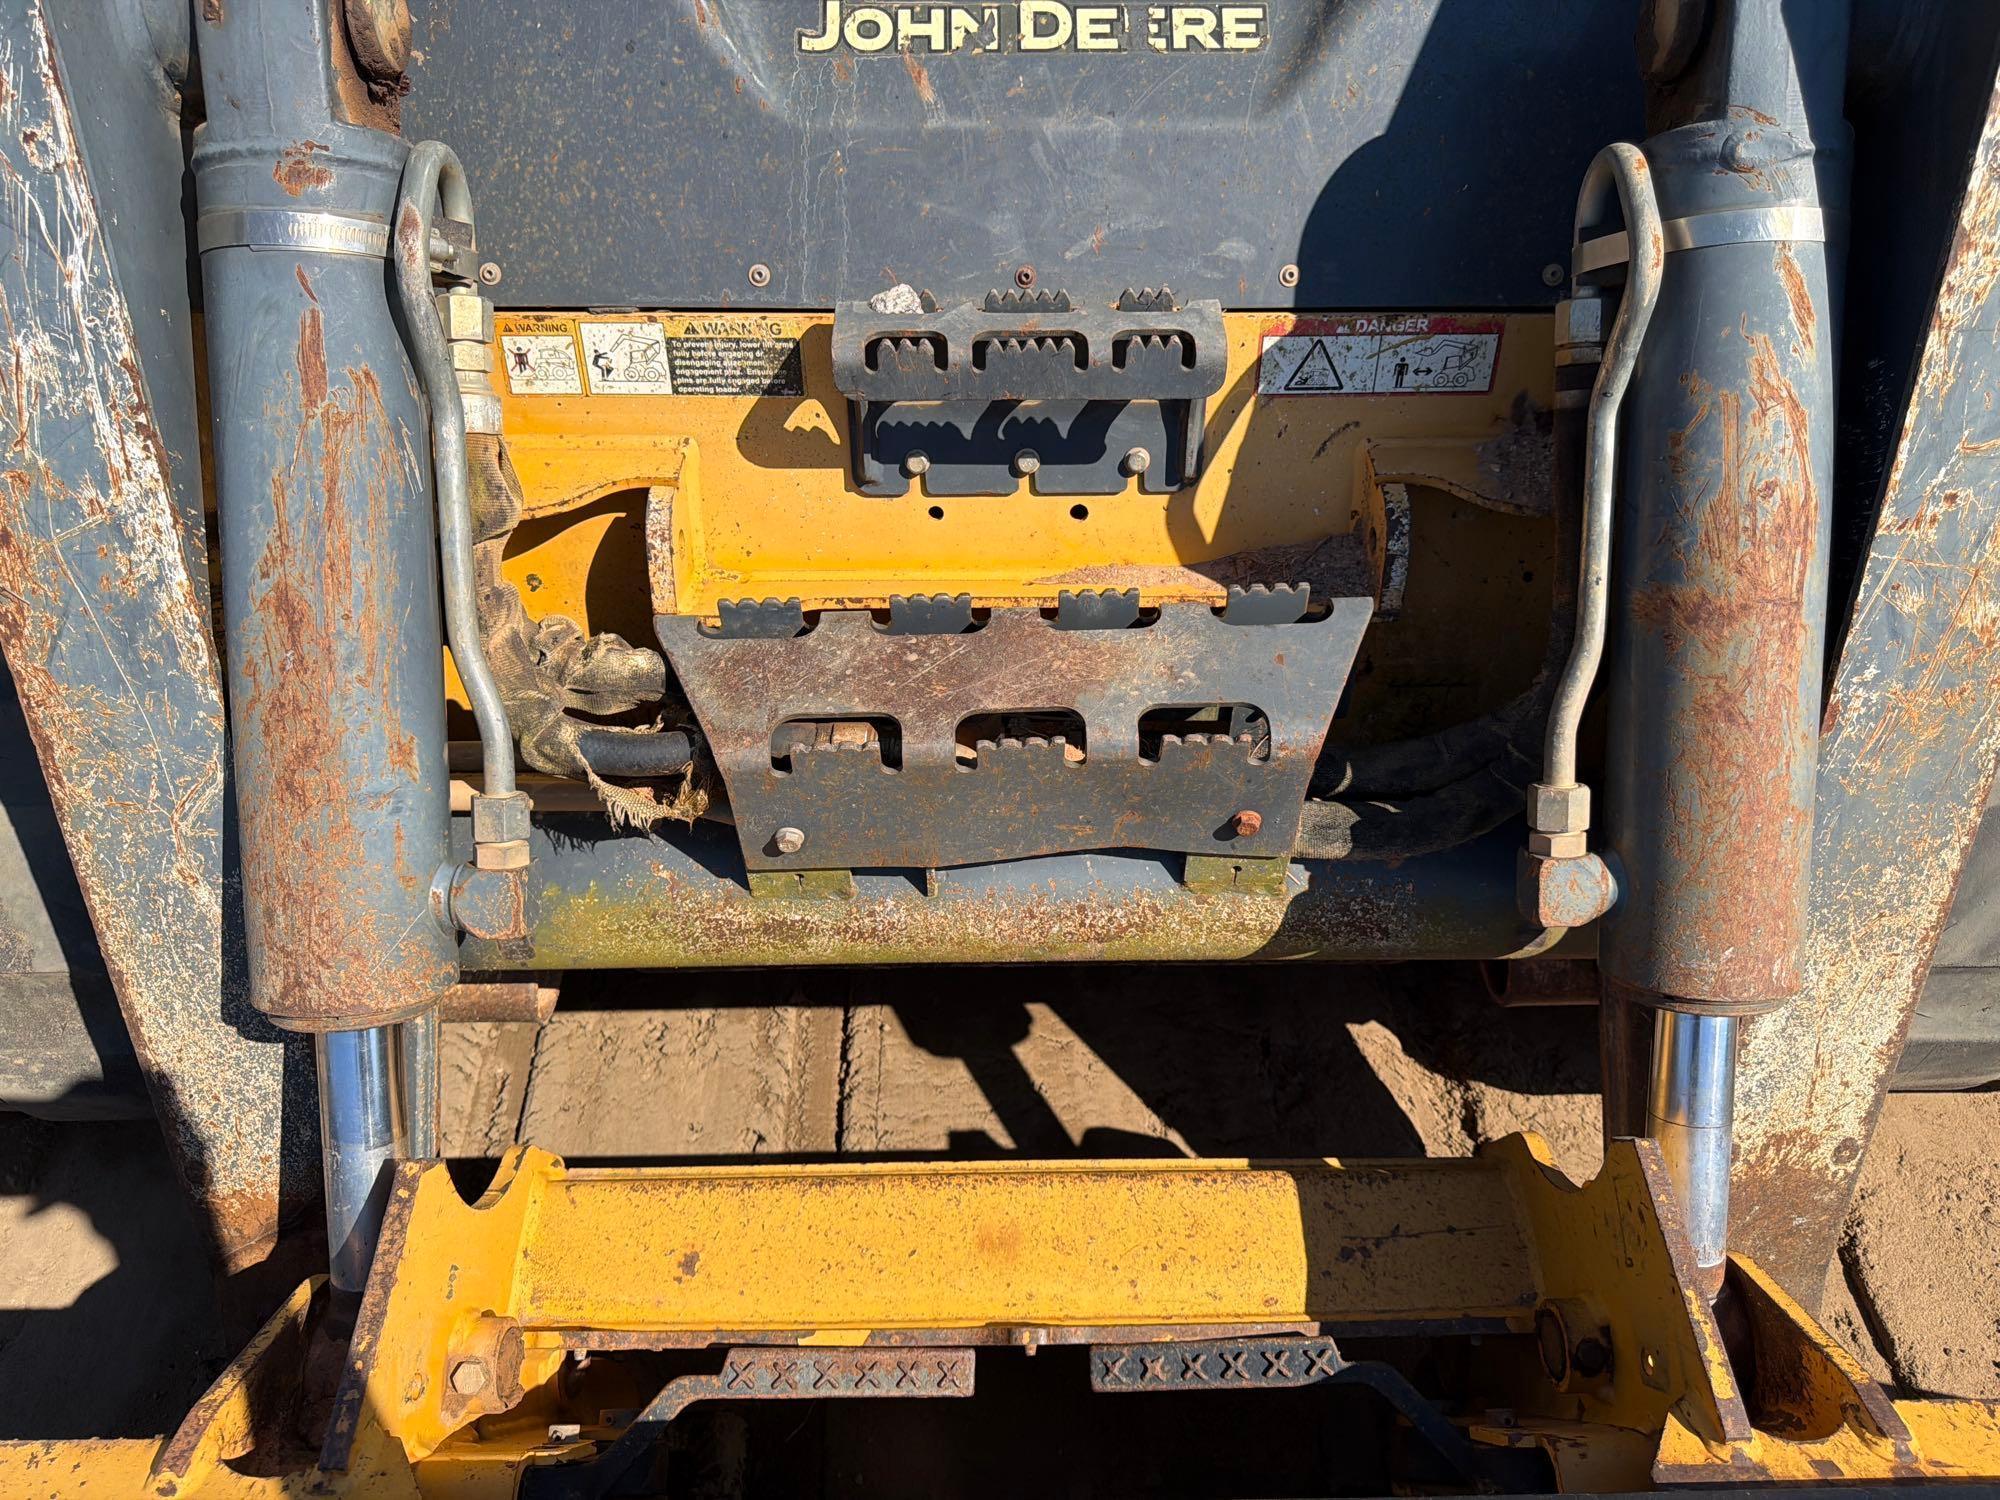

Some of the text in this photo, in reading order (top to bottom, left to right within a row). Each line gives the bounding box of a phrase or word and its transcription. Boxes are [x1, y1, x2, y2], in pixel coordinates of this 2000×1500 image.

[801, 0, 999, 51] JOHN
[514, 323, 568, 333] WARNING
[702, 322, 782, 336] WARNG
[1355, 319, 1430, 333] DANGER
[671, 340, 682, 348] To
[714, 340, 738, 349] injury,
[739, 340, 760, 348] lower
[673, 349, 690, 358] fully
[718, 350, 754, 359] engaging
[674, 358, 721, 367] disengaging
[677, 377, 693, 386] pins
[709, 377, 726, 386] fully
[678, 386, 742, 395] operating loader.
